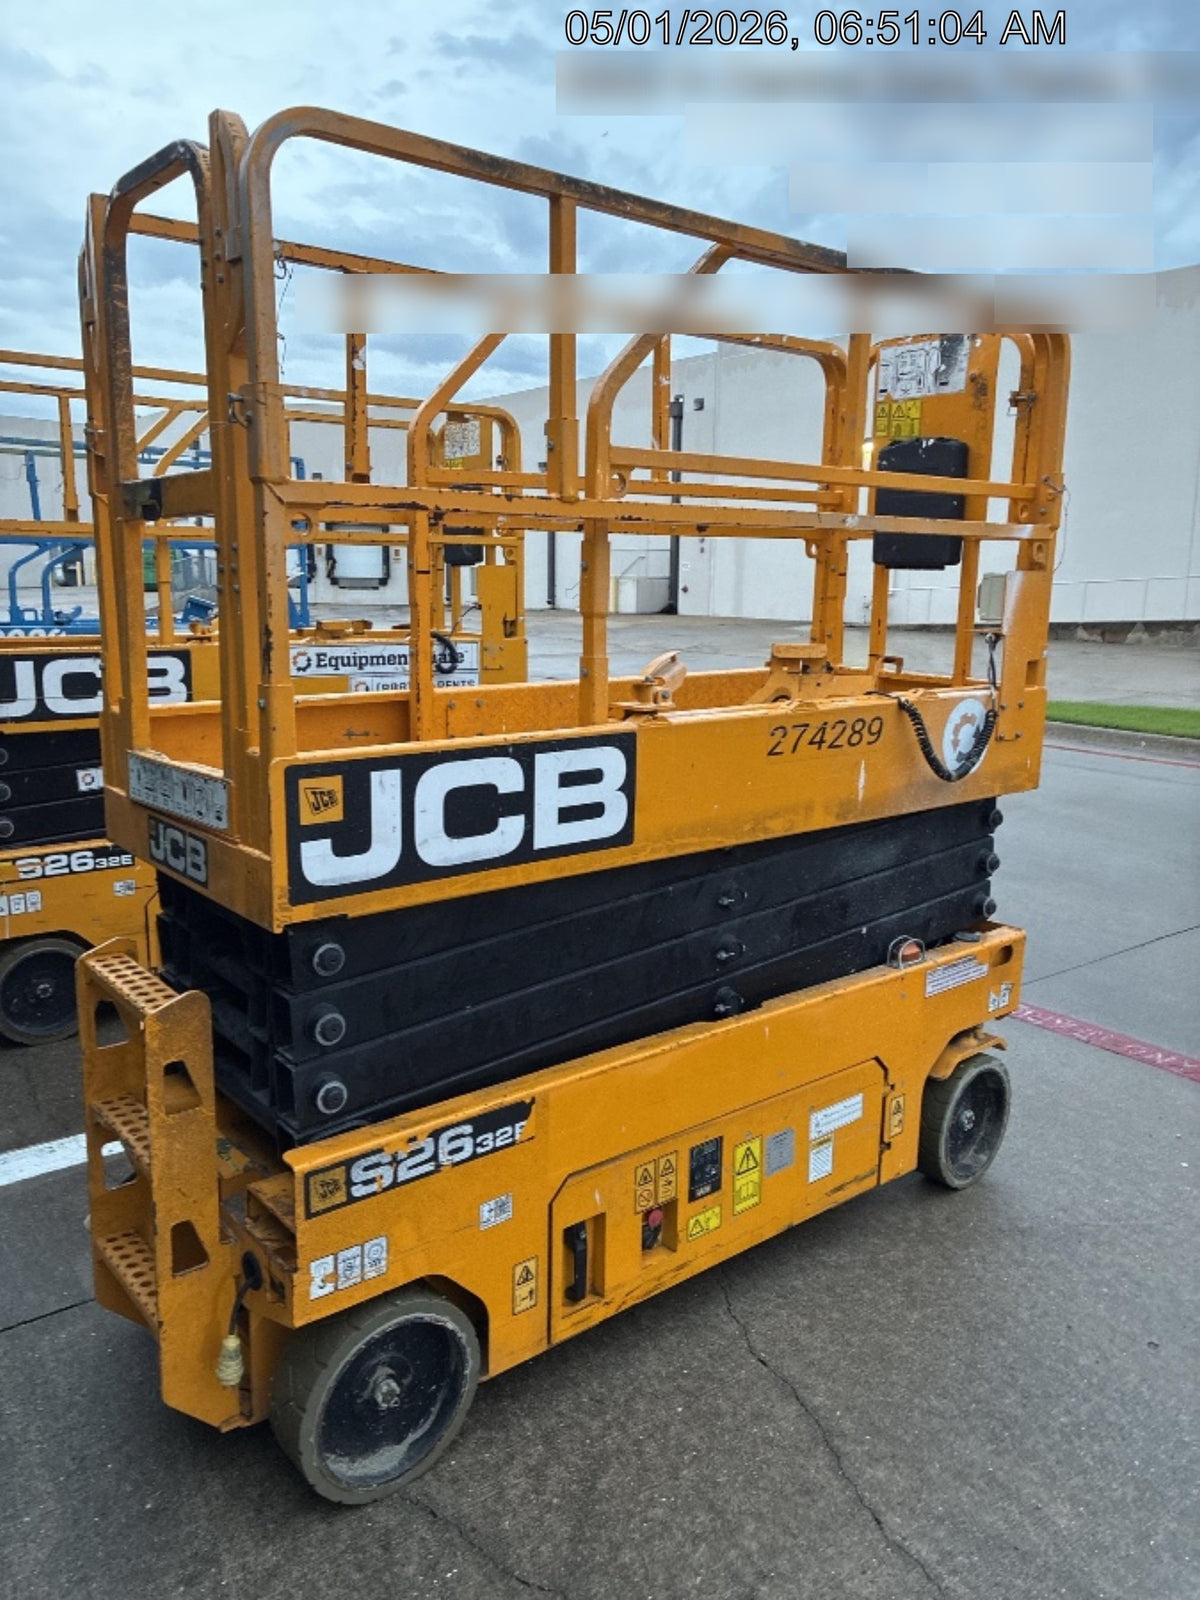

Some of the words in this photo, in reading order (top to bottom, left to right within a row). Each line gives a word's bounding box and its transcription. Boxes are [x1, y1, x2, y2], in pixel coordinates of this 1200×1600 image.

[767, 716, 884, 756] 274289
[300, 745, 629, 886] JCB
[311, 790, 337, 811] JCB
[149, 822, 207, 883] JCB
